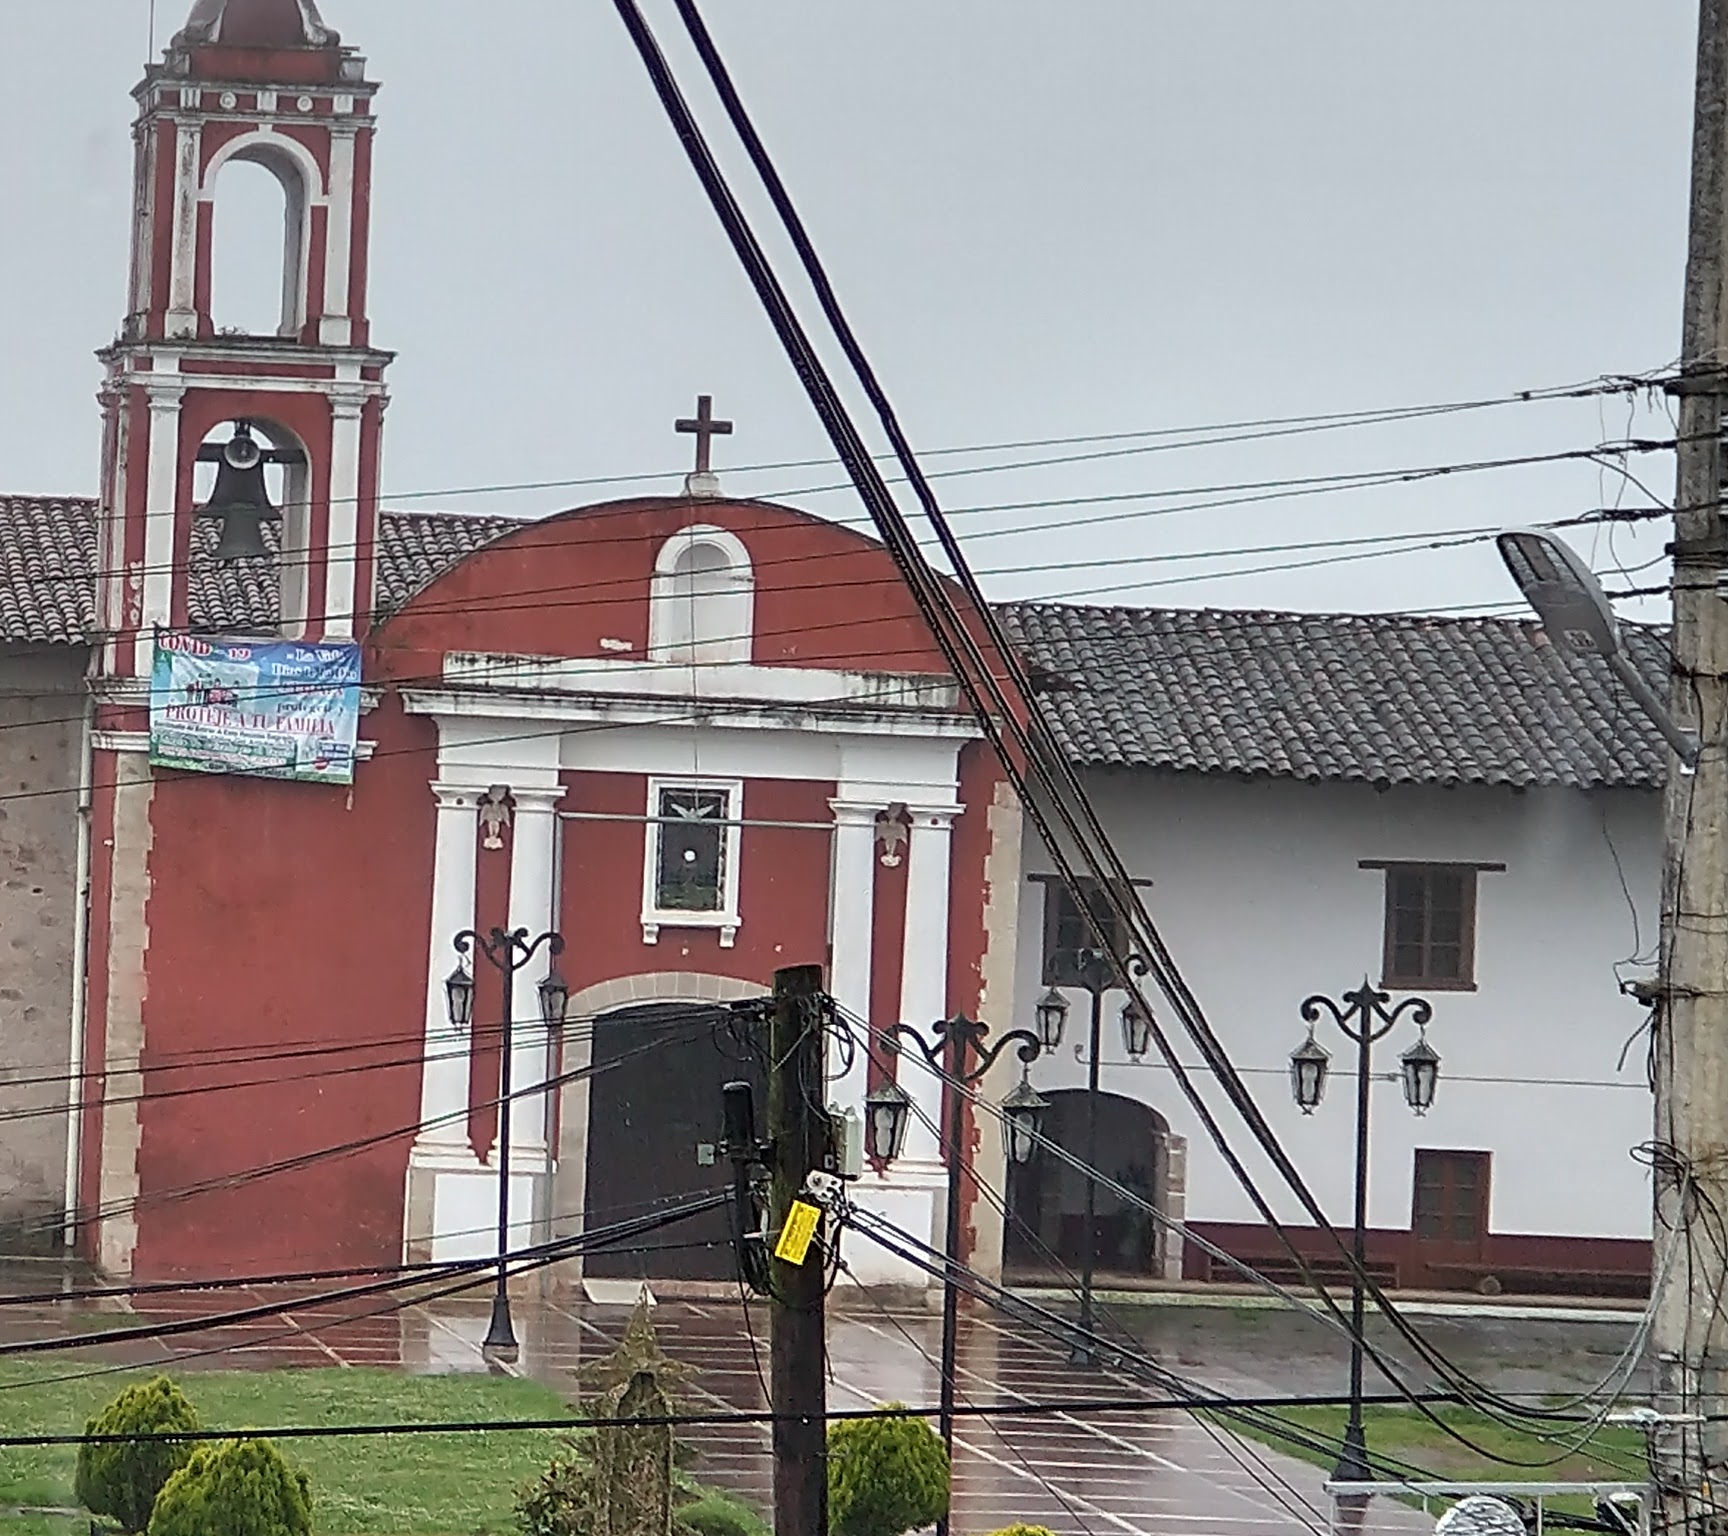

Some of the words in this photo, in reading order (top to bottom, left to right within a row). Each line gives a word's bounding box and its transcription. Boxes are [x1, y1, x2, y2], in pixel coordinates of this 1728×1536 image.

[158, 631, 212, 656] COVID
[164, 704, 233, 727] PROTEJE
[235, 713, 246, 728] A
[276, 715, 334, 734] FAMILIA
